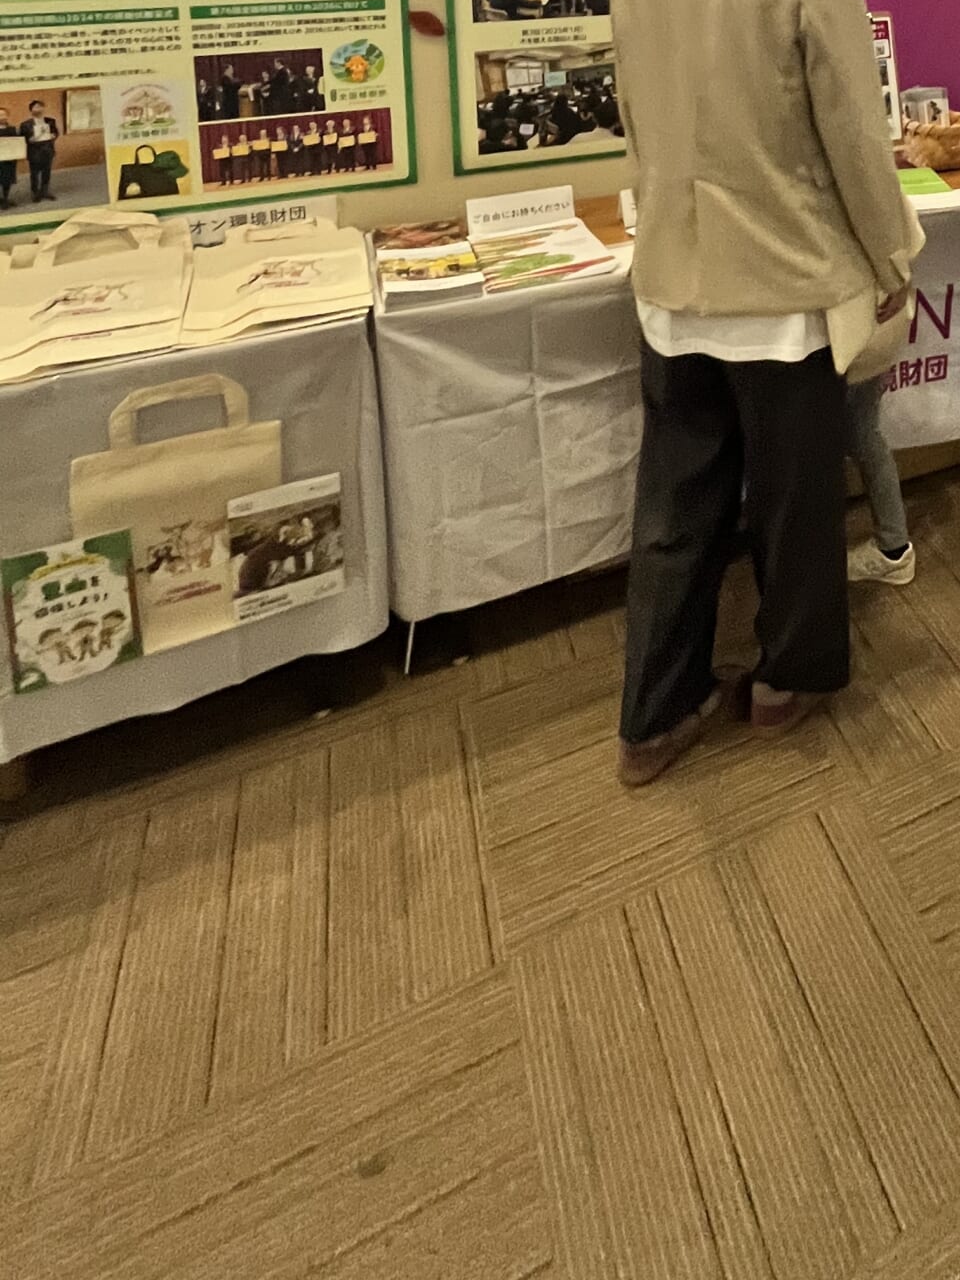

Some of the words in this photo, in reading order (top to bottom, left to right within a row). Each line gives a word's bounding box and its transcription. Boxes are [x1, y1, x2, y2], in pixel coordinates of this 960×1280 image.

[189, 205, 306, 234] オン環境財団
[473, 201, 570, 223] ご自由にお持ちください
